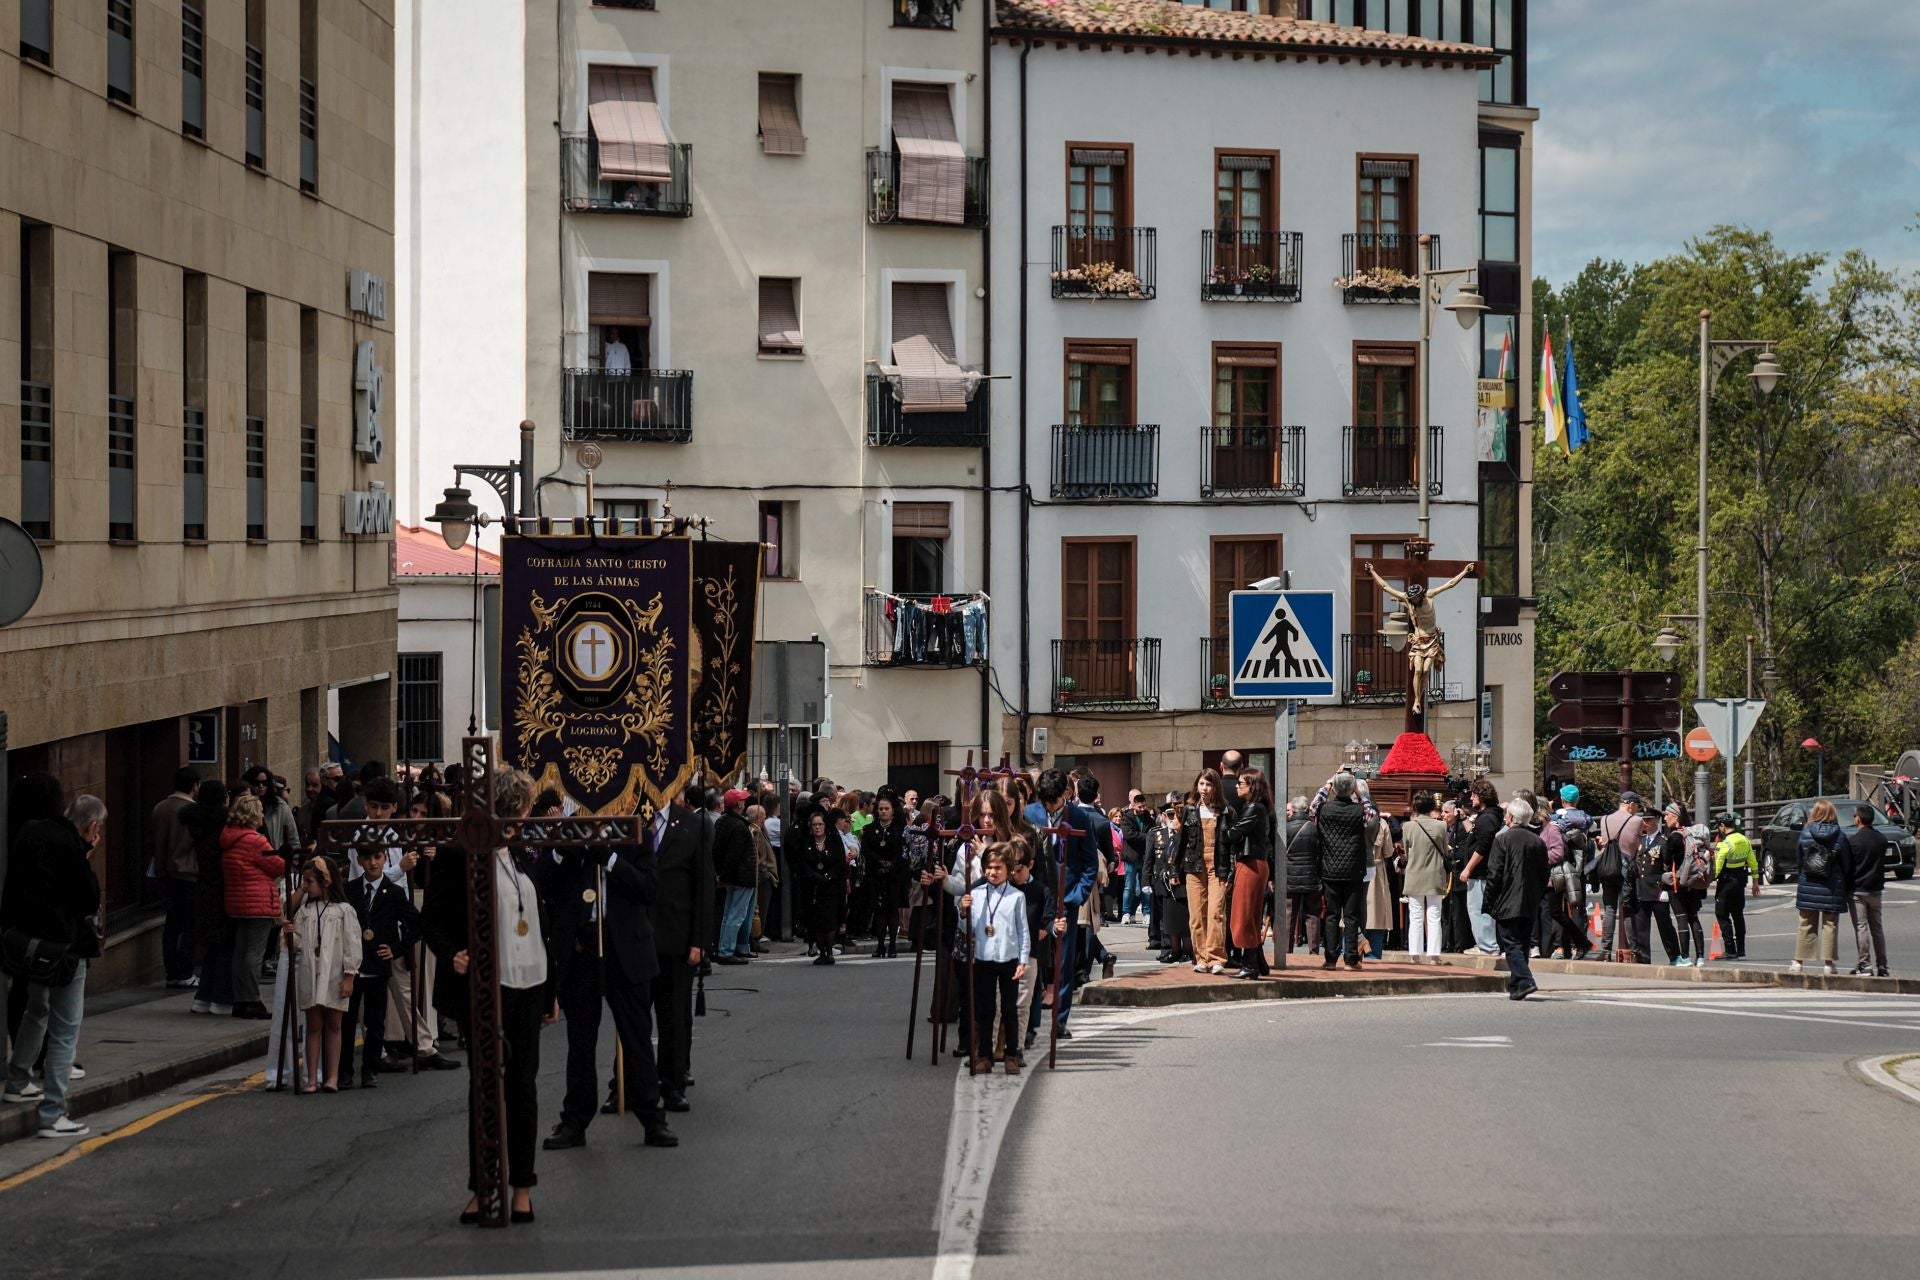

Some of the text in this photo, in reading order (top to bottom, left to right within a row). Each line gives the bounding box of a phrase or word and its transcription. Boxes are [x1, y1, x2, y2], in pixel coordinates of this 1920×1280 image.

[1485, 392, 1490, 403] TI
[527, 556, 667, 569] COFRADÍA SANTO CRISTO
[554, 574, 640, 587] DE LAS ÁNIMAS
[585, 601, 601, 609] 1744
[570, 725, 617, 736] LOGROÑO
